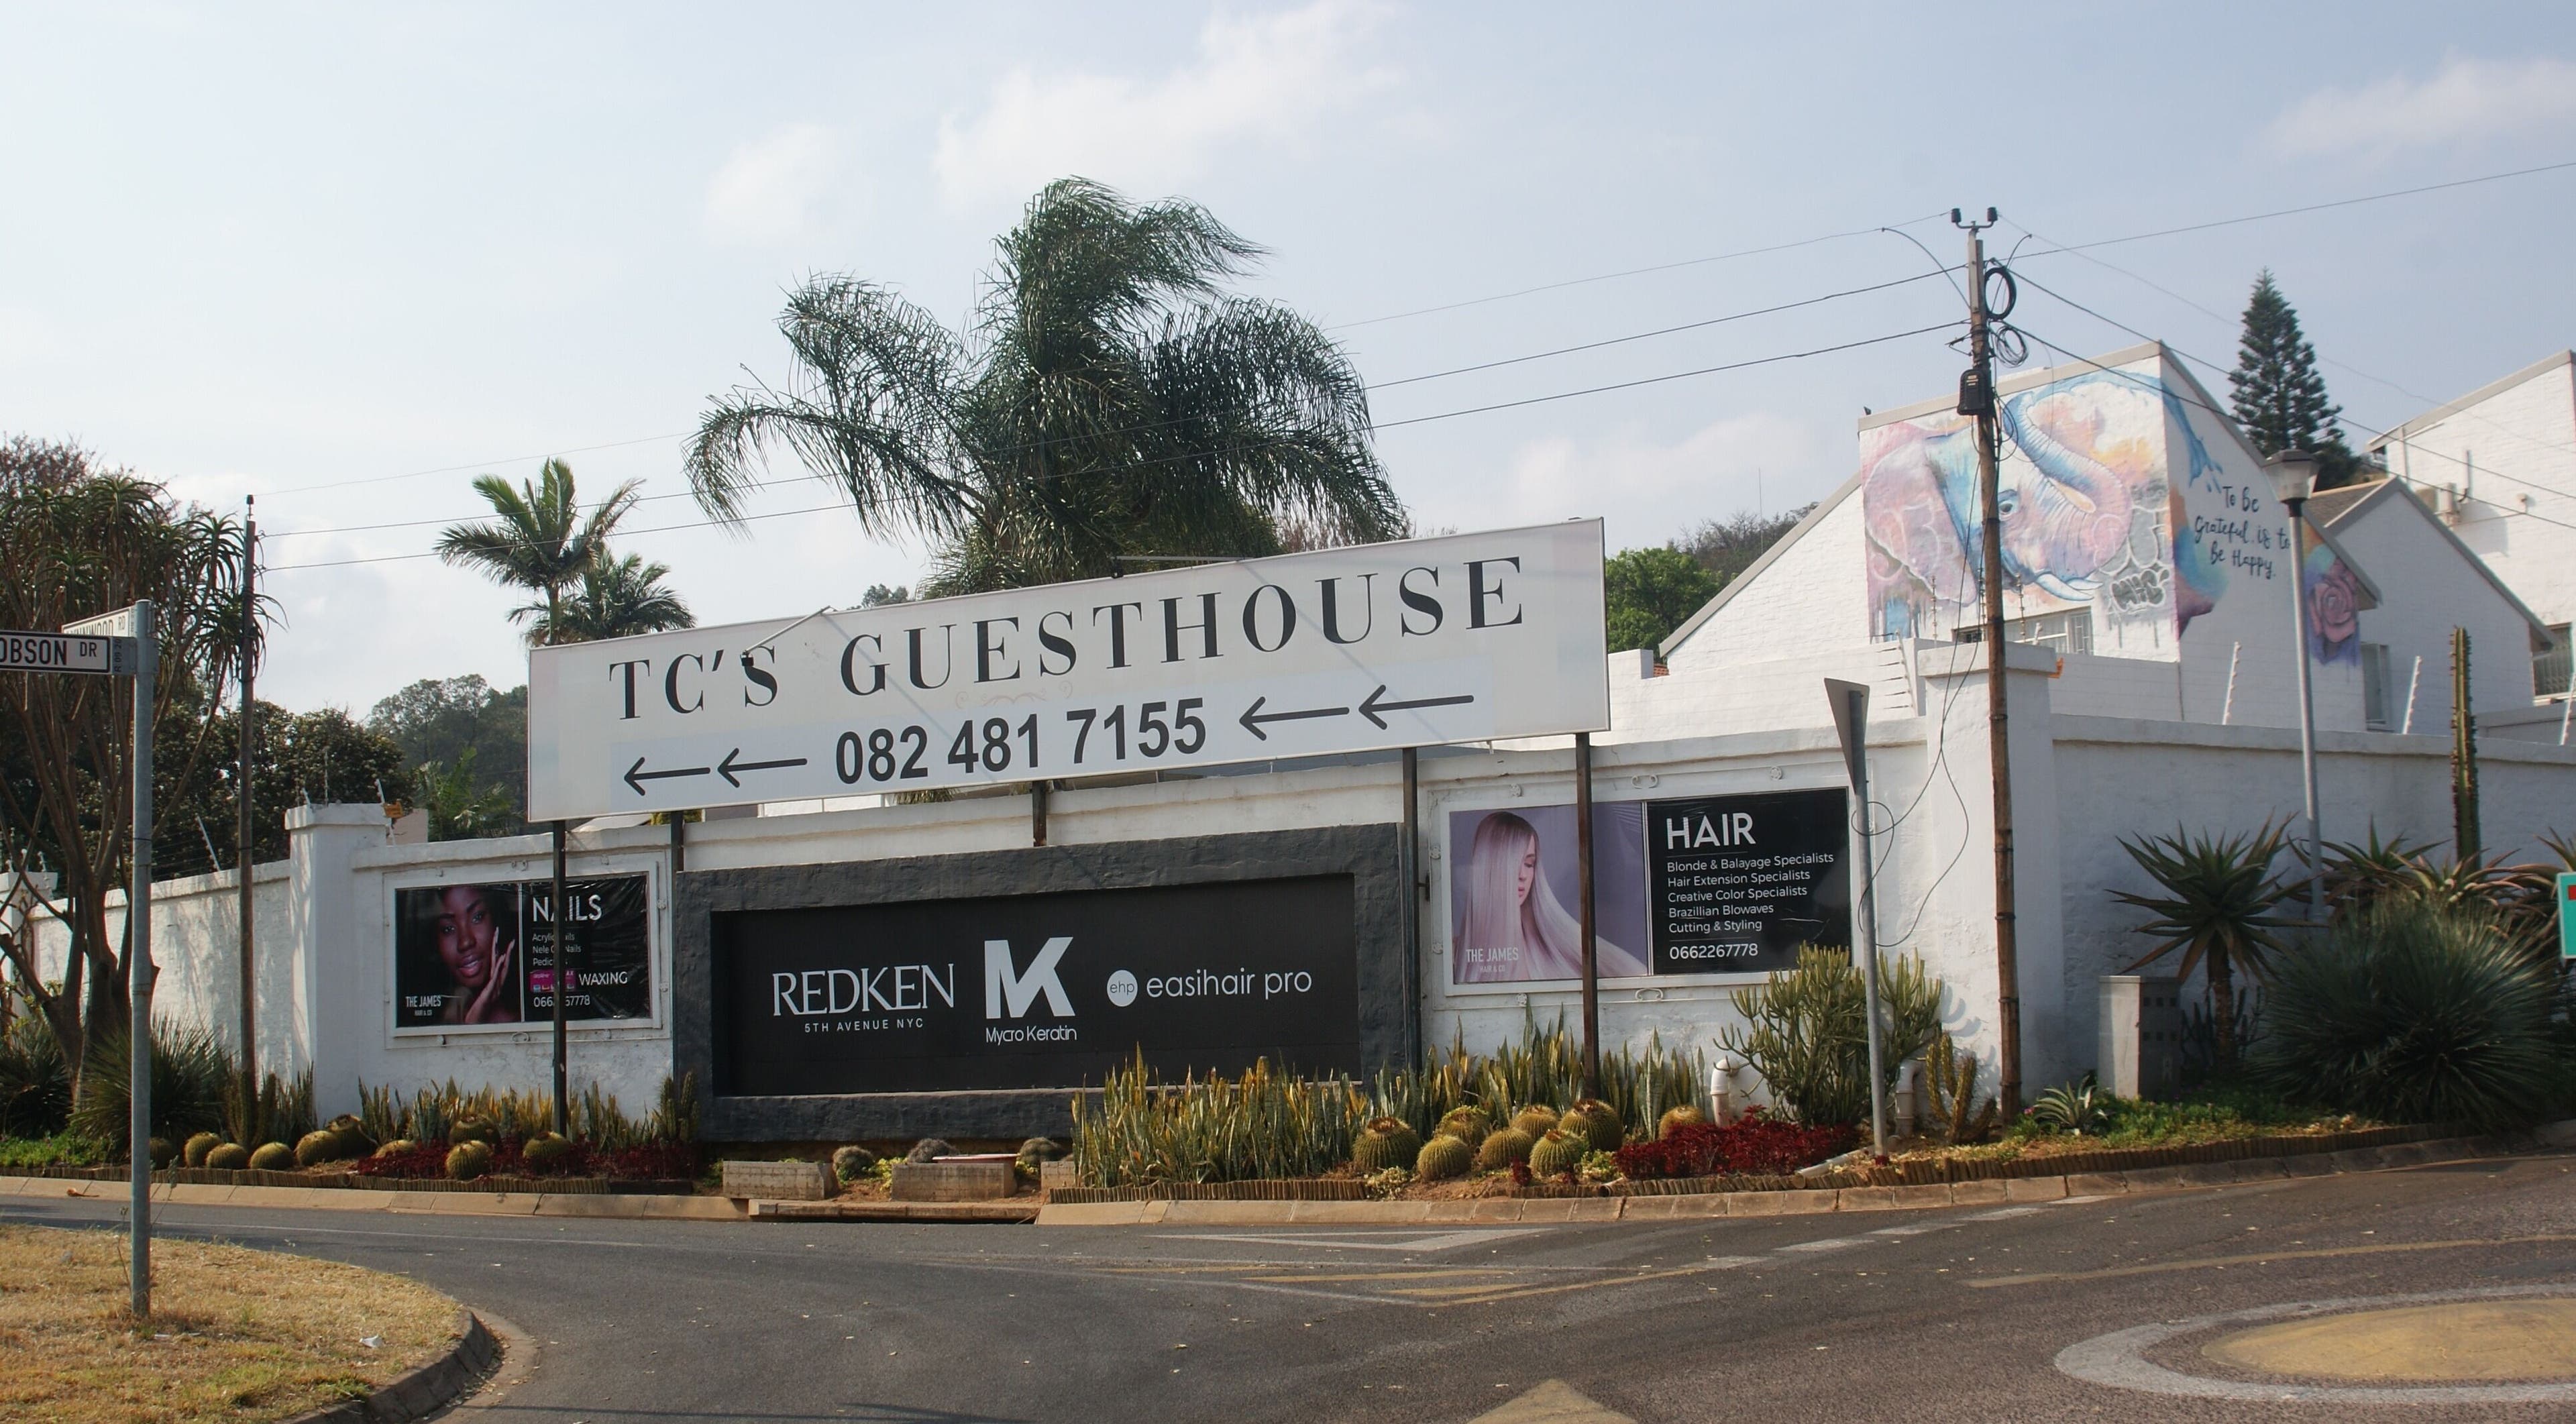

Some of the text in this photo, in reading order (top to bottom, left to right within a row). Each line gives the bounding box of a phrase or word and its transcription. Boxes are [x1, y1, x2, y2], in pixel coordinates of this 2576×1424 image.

[2222, 486, 2236, 508] To
[119, 615, 125, 631] RD
[609, 555, 1523, 720] TC'S GUESTHOUSE
[80, 642, 97, 657] DR
[836, 697, 1206, 784] 082 481 7155
[1666, 812, 1756, 849] HAIR
[1667, 853, 1834, 872] Blonde & Balayage Specialists
[1668, 871, 1811, 887] Hair Extension Specialists
[1668, 886, 1807, 903] Creative Color Specialists
[1668, 904, 1774, 918] Brazillian Blowaves
[1668, 920, 1762, 934] Cutting & Styling
[1466, 947, 1519, 963] THE JAMES
[1670, 943, 1758, 959] 0662267778
[579, 971, 628, 985] WAXING
[1146, 967, 1312, 1000] easihair pro
[772, 963, 954, 1016] REDKEN
[1110, 980, 1135, 995] ehp
[405, 995, 441, 1007] THE JAMES
[805, 1018, 924, 1033] 5TH AVENUE NYC
[985, 1025, 1077, 1046] Mycro Keratin
